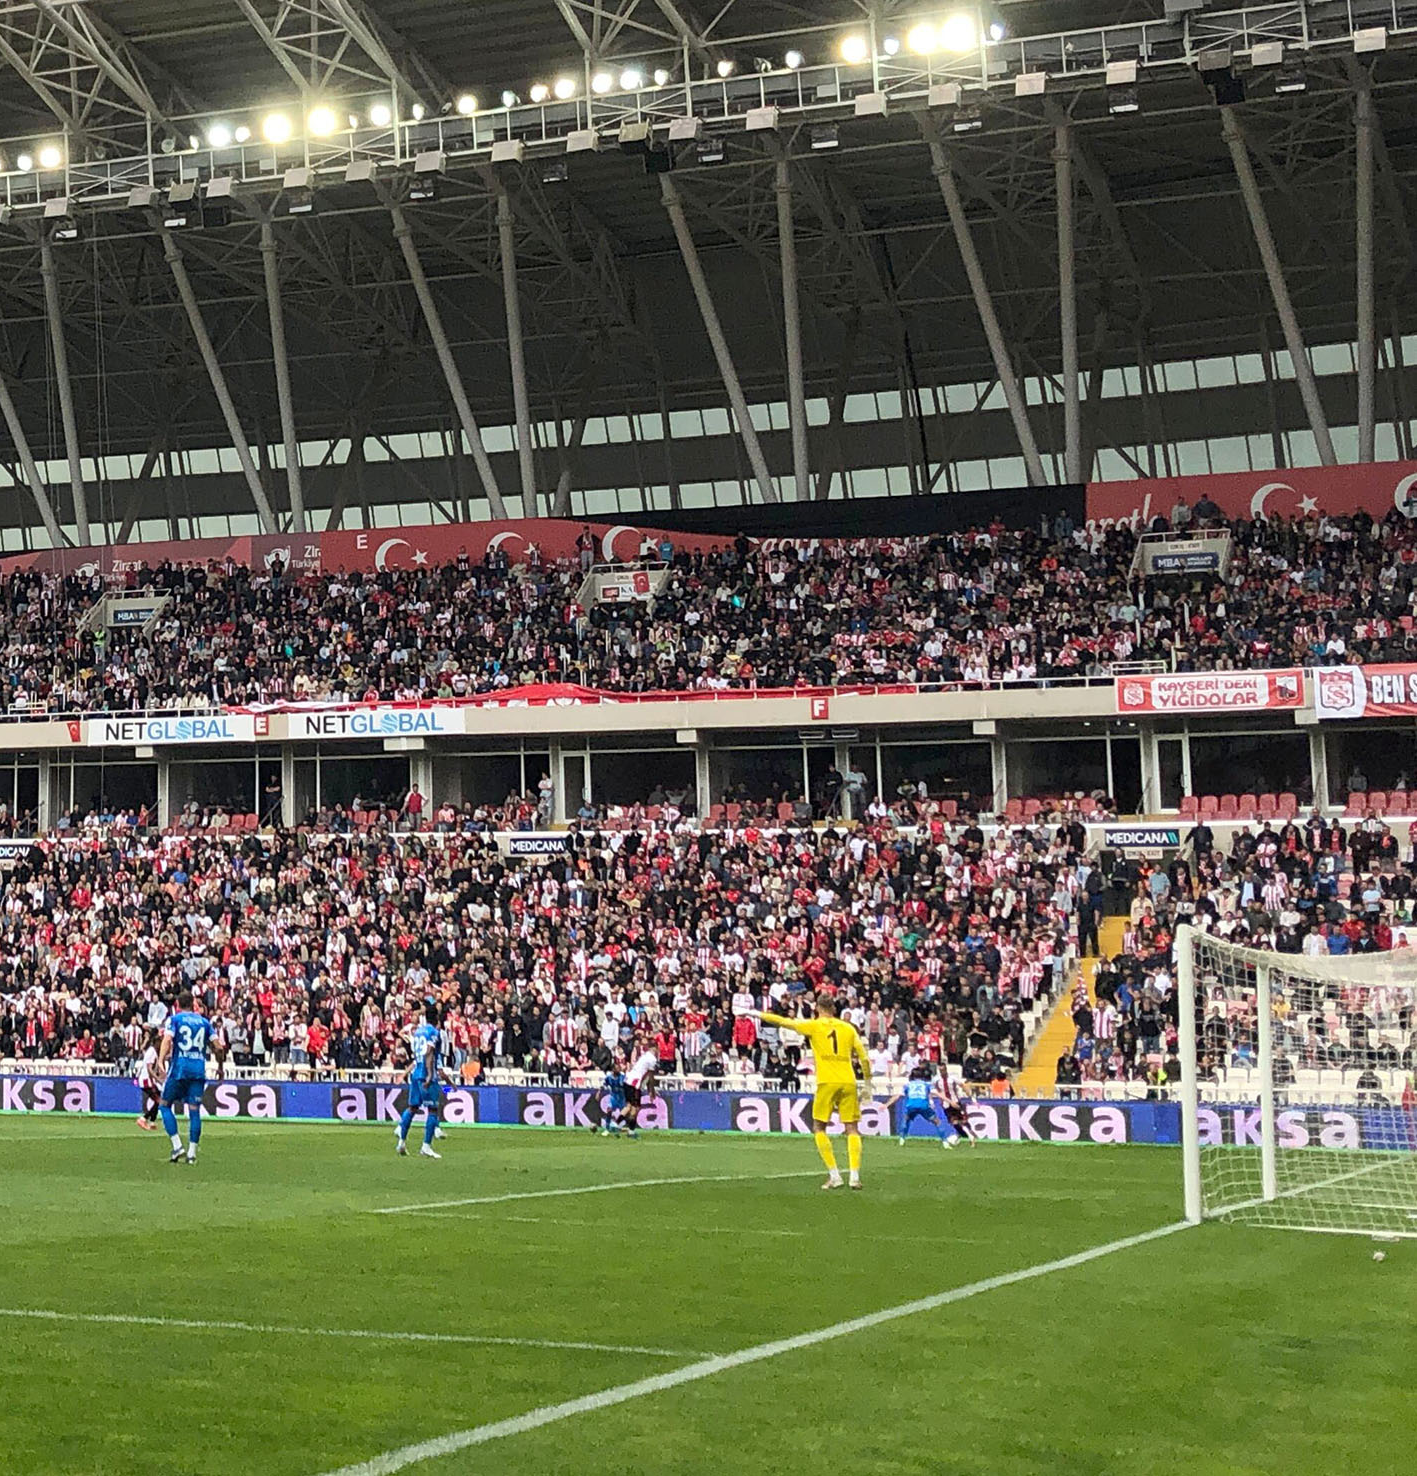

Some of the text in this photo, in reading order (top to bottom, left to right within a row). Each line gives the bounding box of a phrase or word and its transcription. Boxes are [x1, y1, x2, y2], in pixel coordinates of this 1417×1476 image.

[357, 534, 368, 549] E
[1372, 674, 1406, 704] BEN
[813, 699, 825, 716] F
[105, 717, 235, 741] NETGLOBAL
[255, 716, 267, 733] E
[306, 711, 444, 735] NETGLOBAL
[511, 840, 564, 852] MEDICANA
[1106, 832, 1170, 844] MEDICANA
[177, 1025, 206, 1051] 34
[827, 1029, 838, 1055] 1
[336, 1087, 475, 1124] aka
[736, 1096, 891, 1136] aka
[966, 1103, 1127, 1145] aksa
